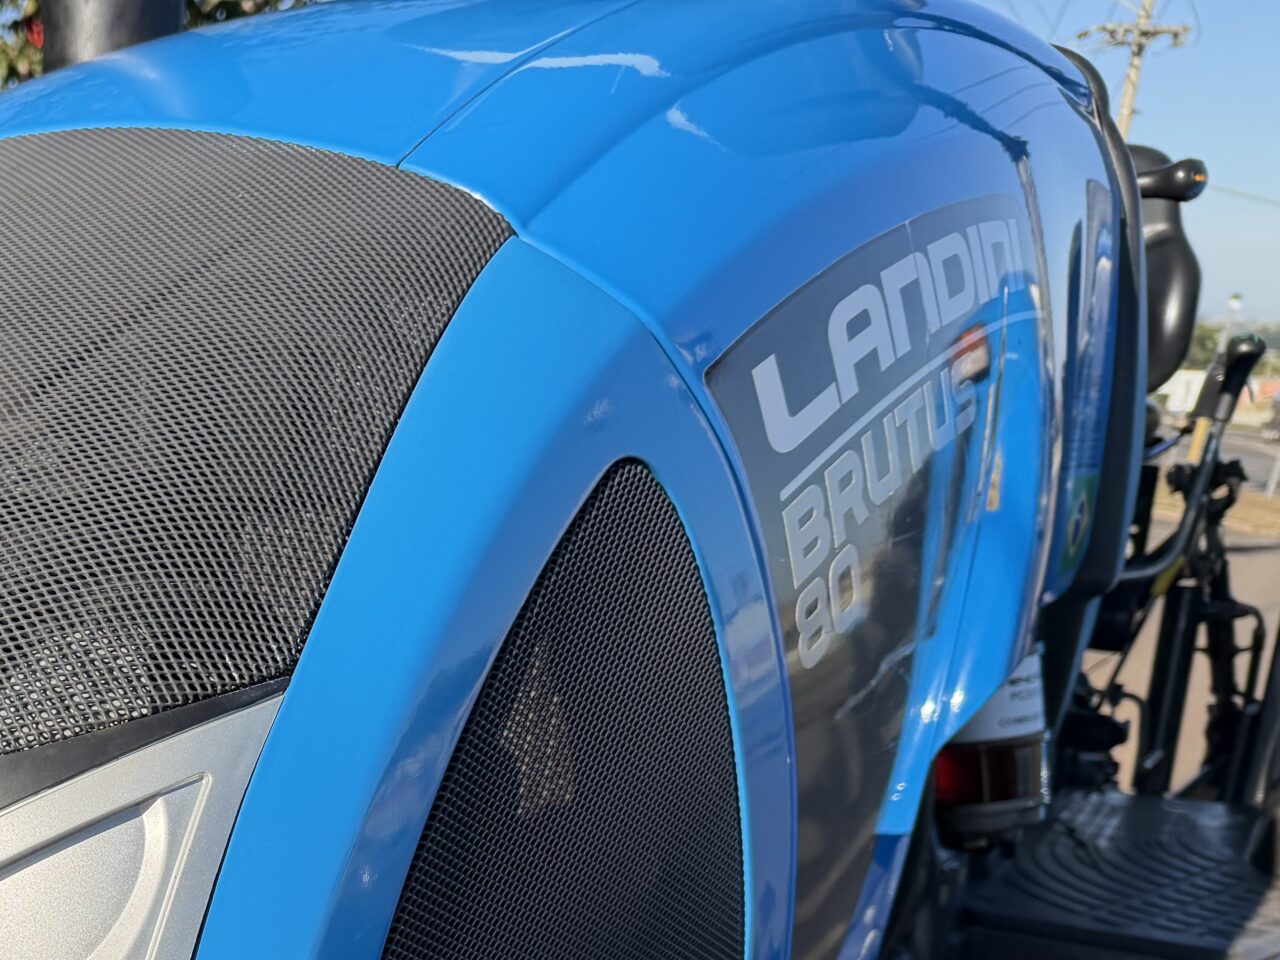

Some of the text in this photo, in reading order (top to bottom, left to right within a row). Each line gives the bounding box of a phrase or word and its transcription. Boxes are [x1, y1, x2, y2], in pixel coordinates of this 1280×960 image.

[751, 218, 1025, 454] LANDINI
[782, 350, 977, 590] BRUTUS
[795, 543, 868, 670] 80
